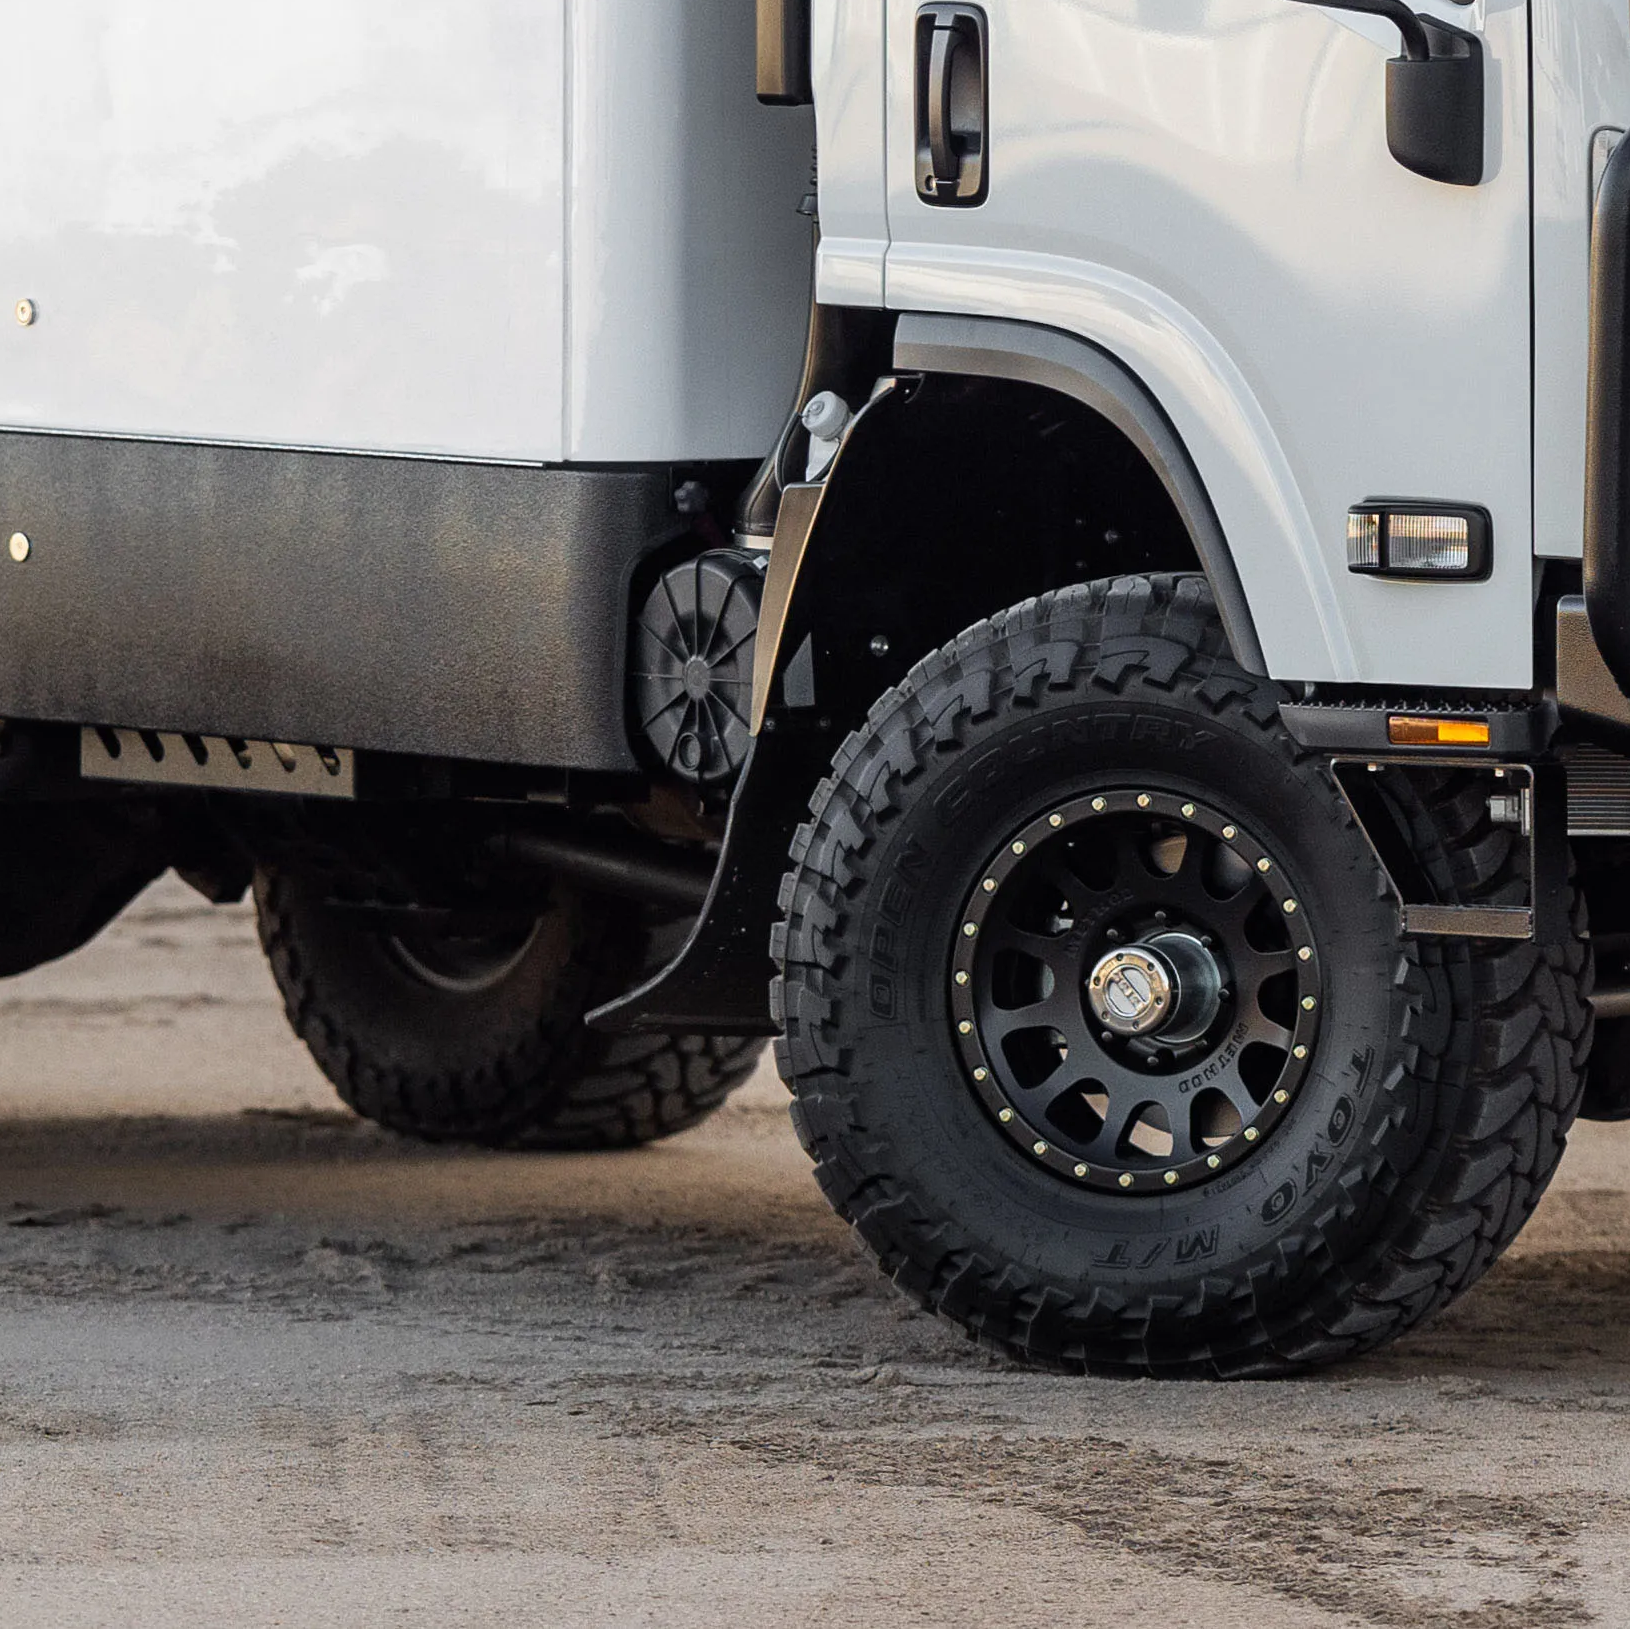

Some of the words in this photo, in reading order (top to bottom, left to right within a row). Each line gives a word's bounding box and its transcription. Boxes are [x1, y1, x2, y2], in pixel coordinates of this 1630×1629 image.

[867, 832, 931, 1020] OPEN
[1178, 1022, 1249, 1094] METHOD
[1258, 1043, 1374, 1227] TOYO
[1091, 1224, 1221, 1270] M/T
